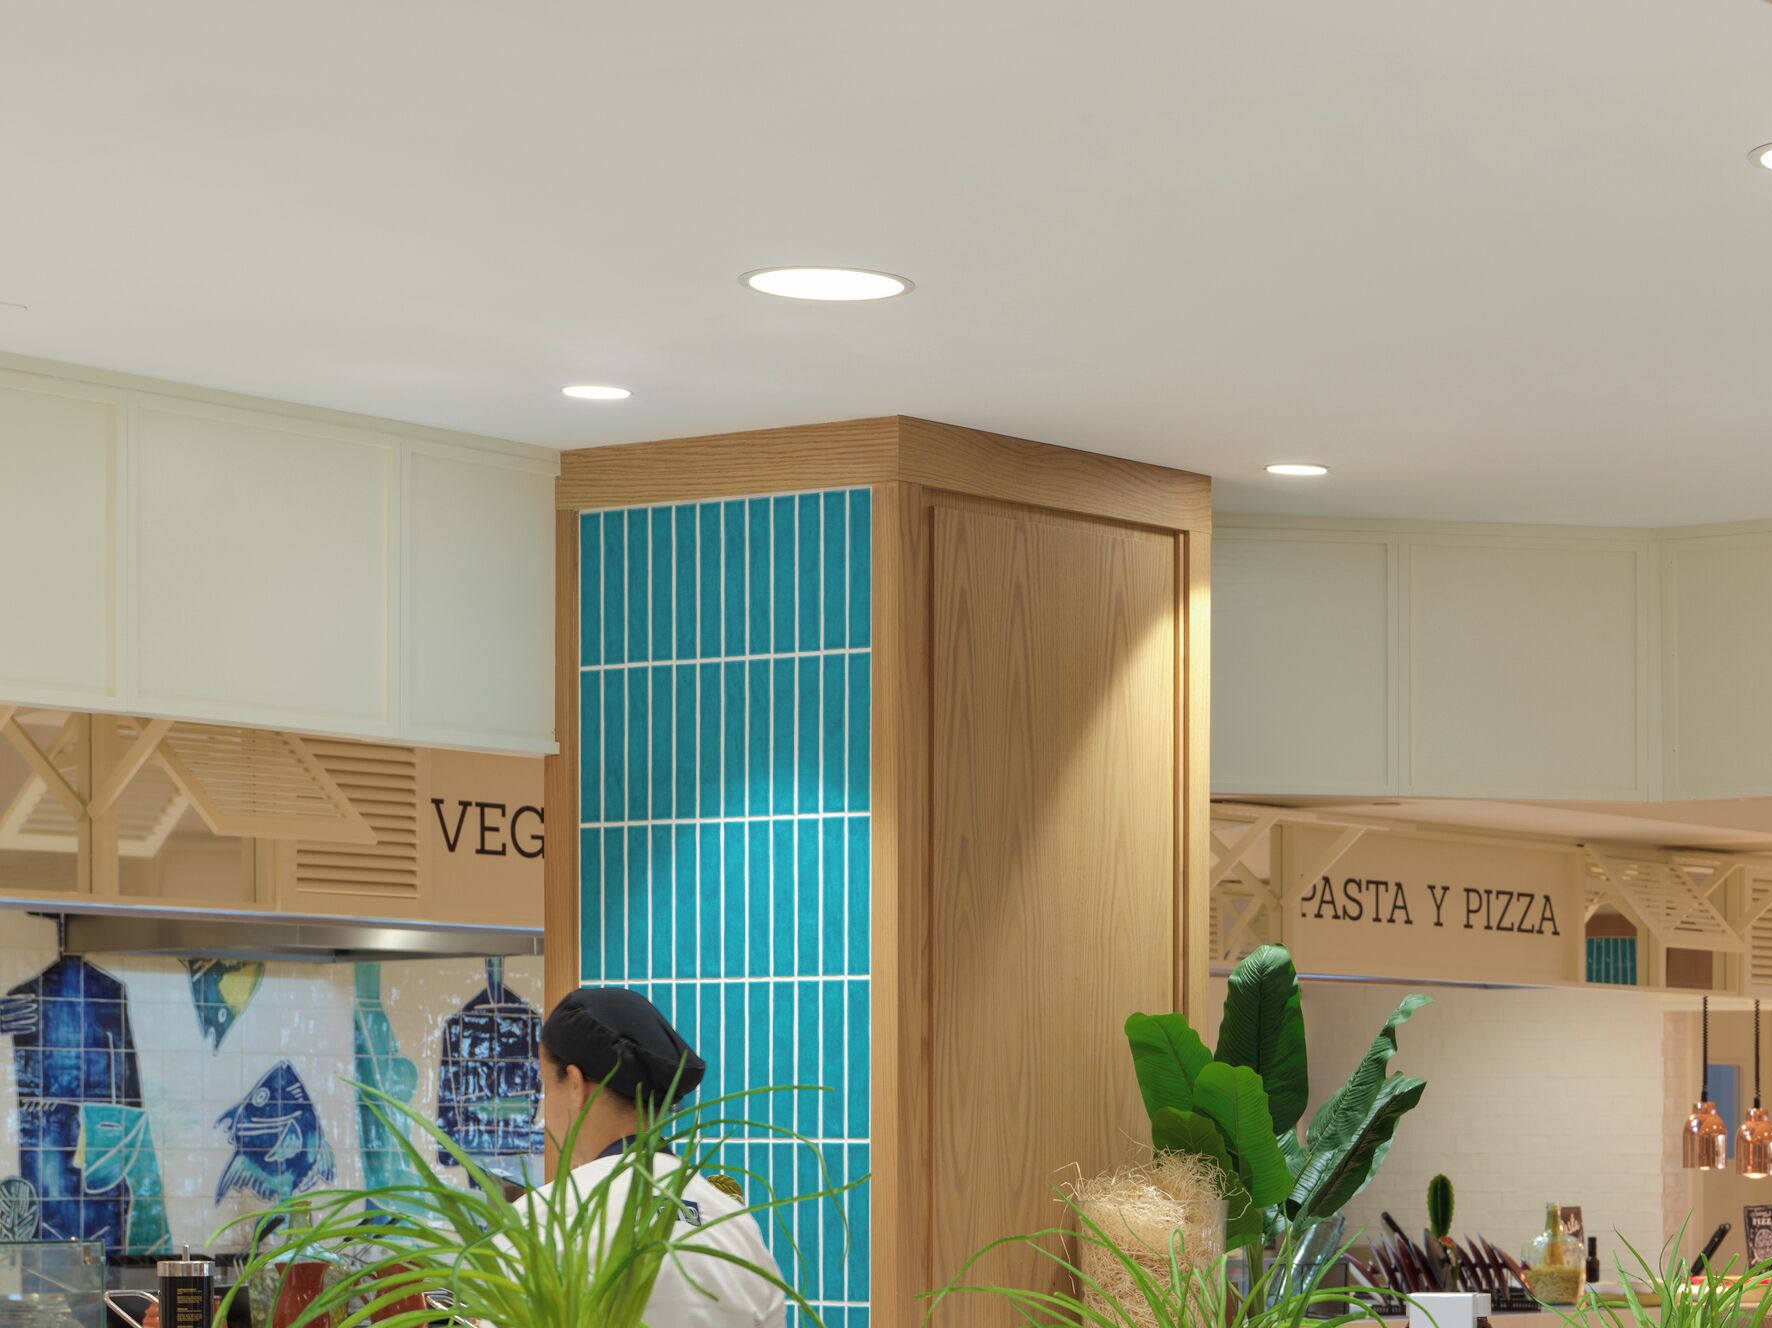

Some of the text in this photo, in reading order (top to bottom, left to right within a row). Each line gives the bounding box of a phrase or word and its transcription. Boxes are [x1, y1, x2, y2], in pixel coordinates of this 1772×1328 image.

[430, 797, 545, 860] VEG
[1426, 884, 1451, 928] Y
[1463, 887, 1561, 937] PIZZA
